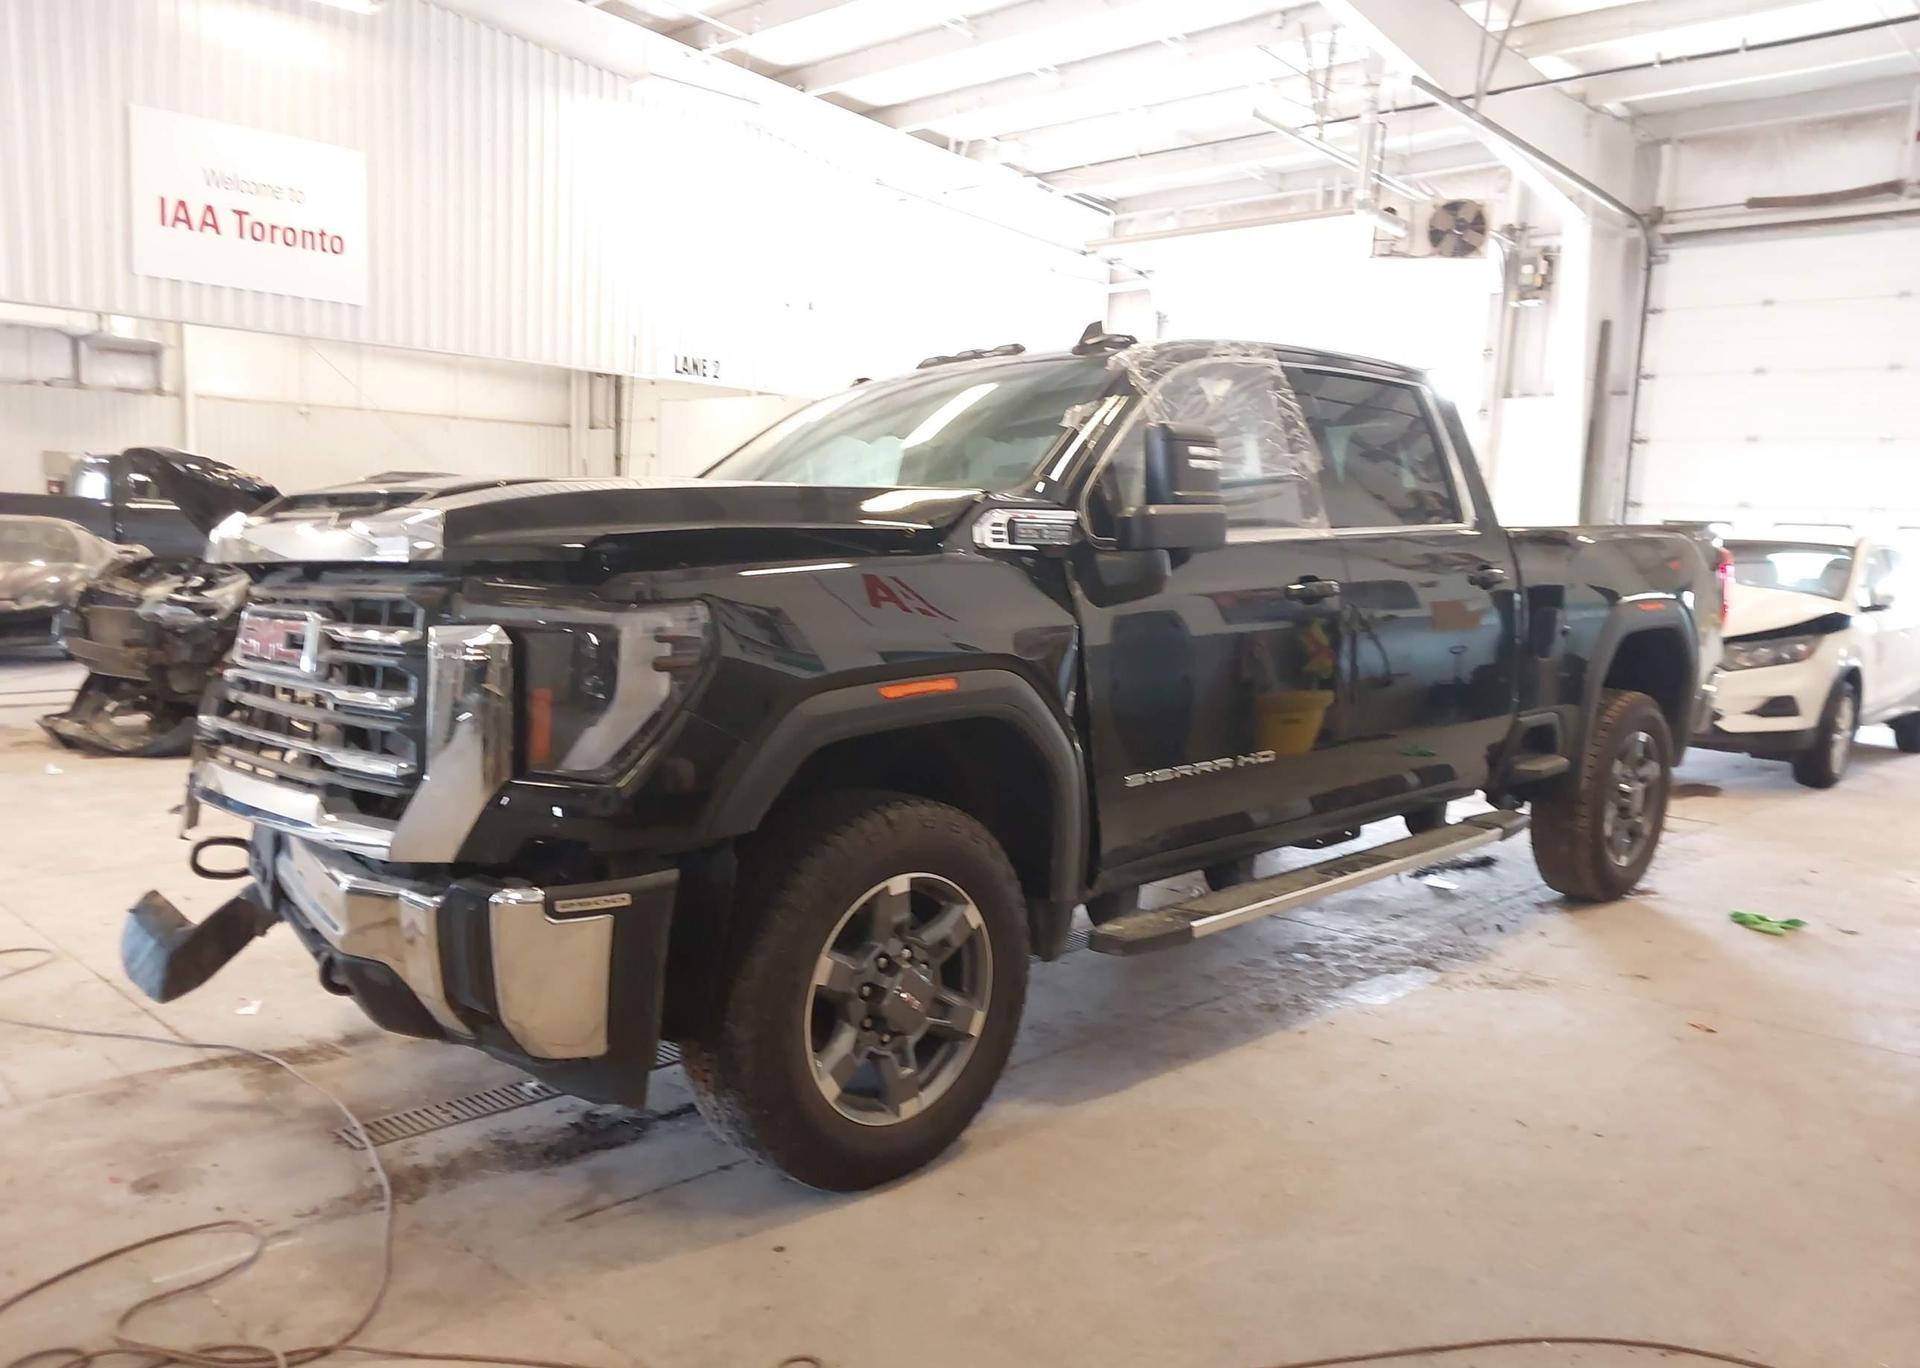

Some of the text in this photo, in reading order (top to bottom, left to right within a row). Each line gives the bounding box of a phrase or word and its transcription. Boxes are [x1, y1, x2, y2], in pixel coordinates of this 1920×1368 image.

[202, 167, 306, 204] Welcome to
[157, 195, 345, 256] IAA Toronto
[674, 354, 720, 379] LANE 2
